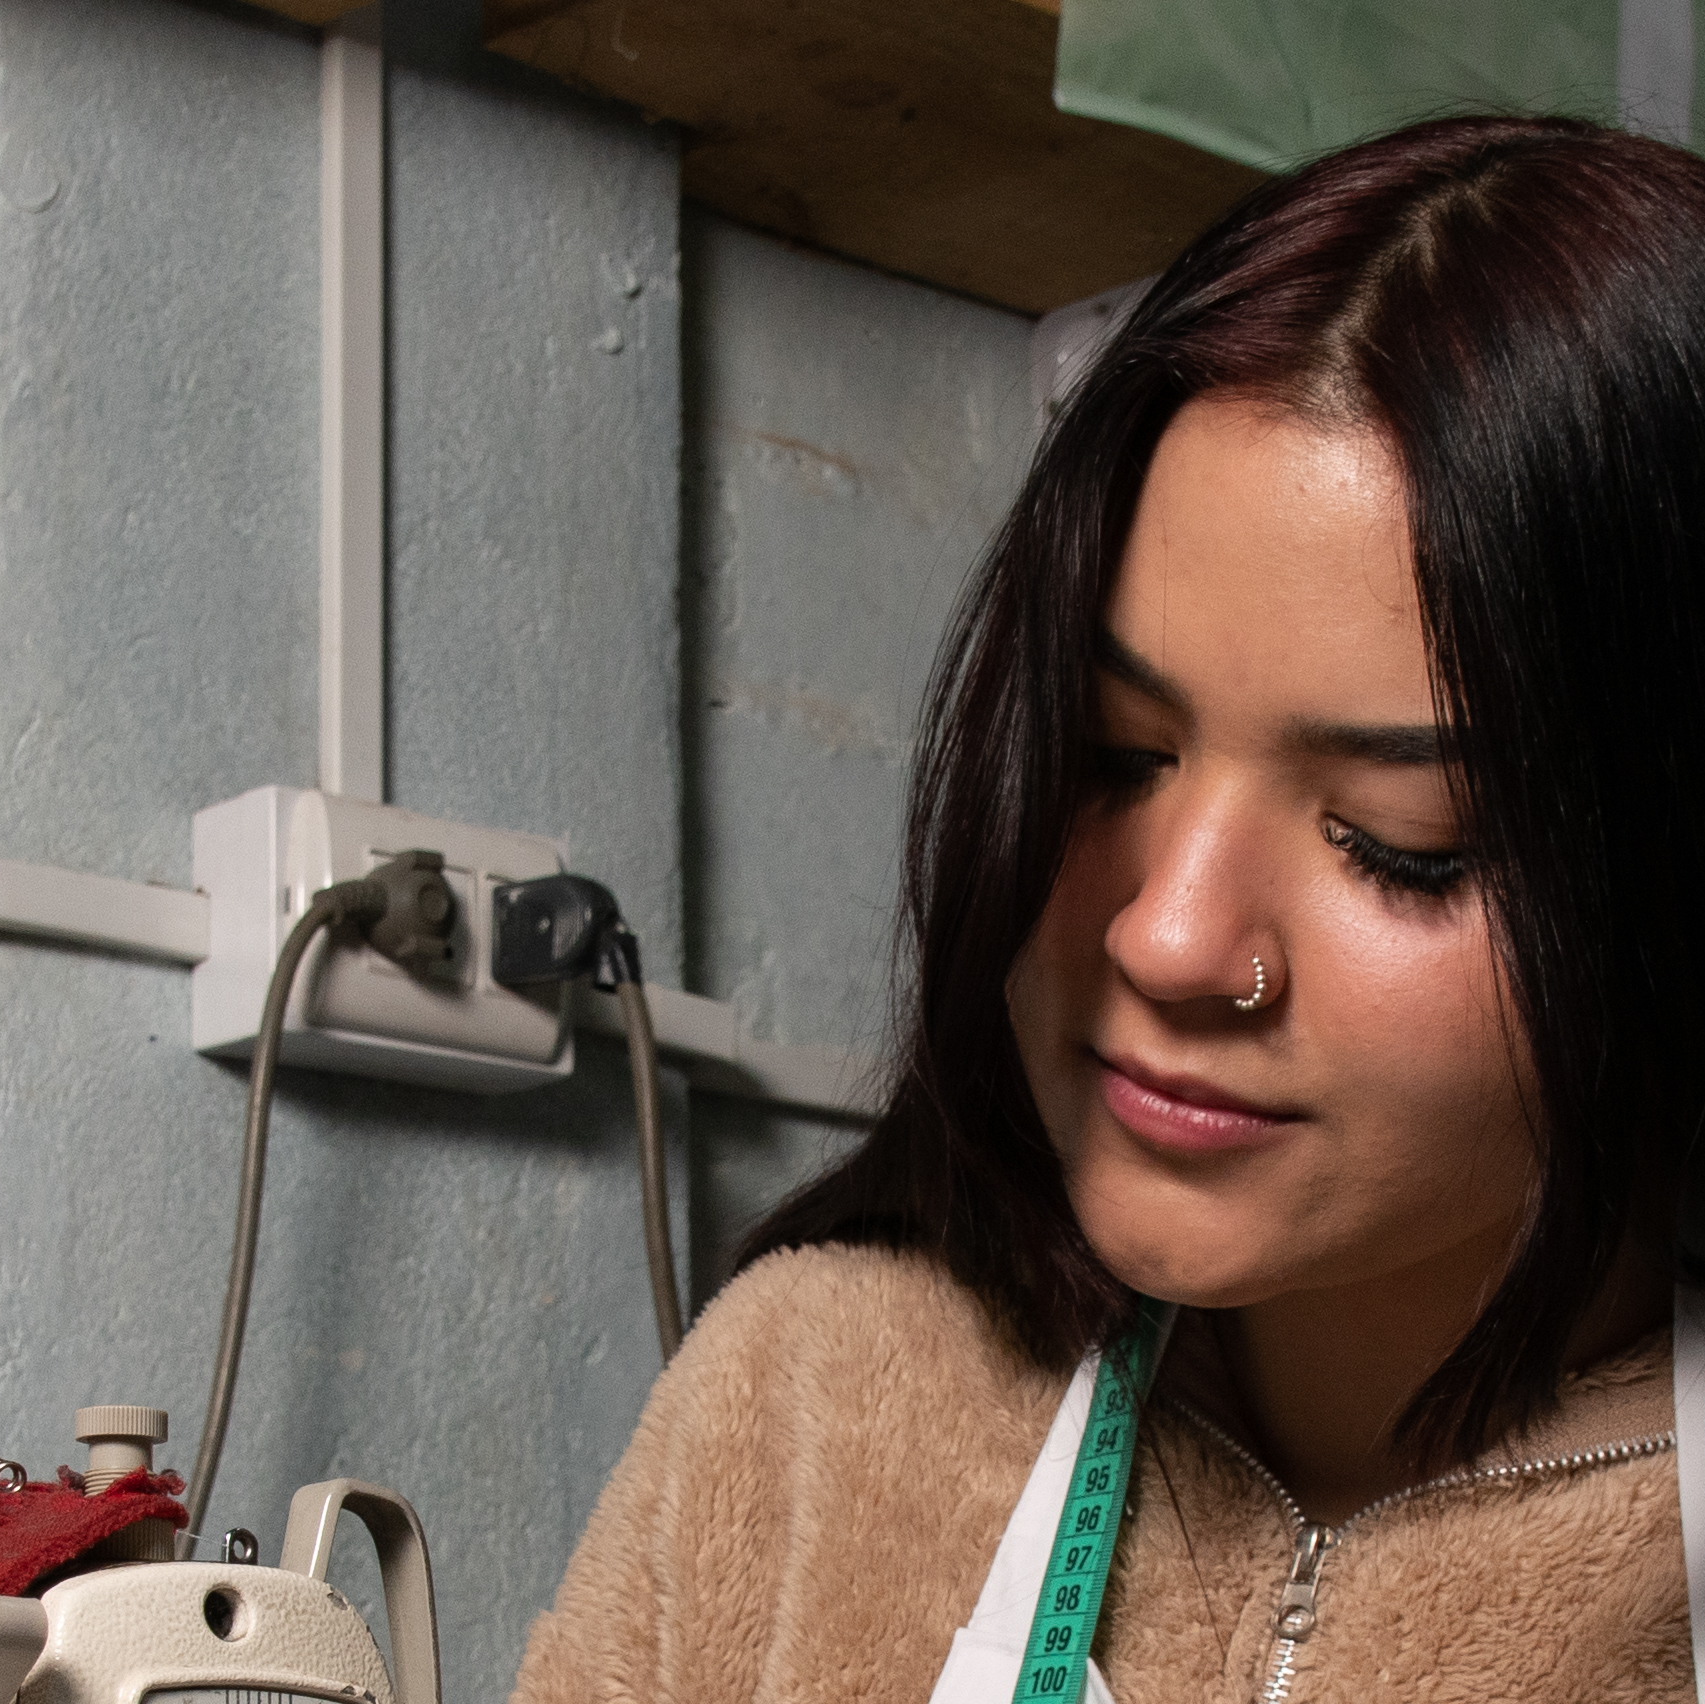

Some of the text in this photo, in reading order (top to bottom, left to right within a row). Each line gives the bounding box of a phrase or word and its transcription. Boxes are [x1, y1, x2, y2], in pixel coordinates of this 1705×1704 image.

[1095, 1426, 1119, 1451] 94
[1085, 1466, 1110, 1492] 95
[1075, 1506, 1101, 1532] 96
[1065, 1546, 1093, 1571] 97
[1054, 1584, 1081, 1611] 98
[1044, 1626, 1072, 1651] 99
[1031, 1666, 1066, 1694] 100
